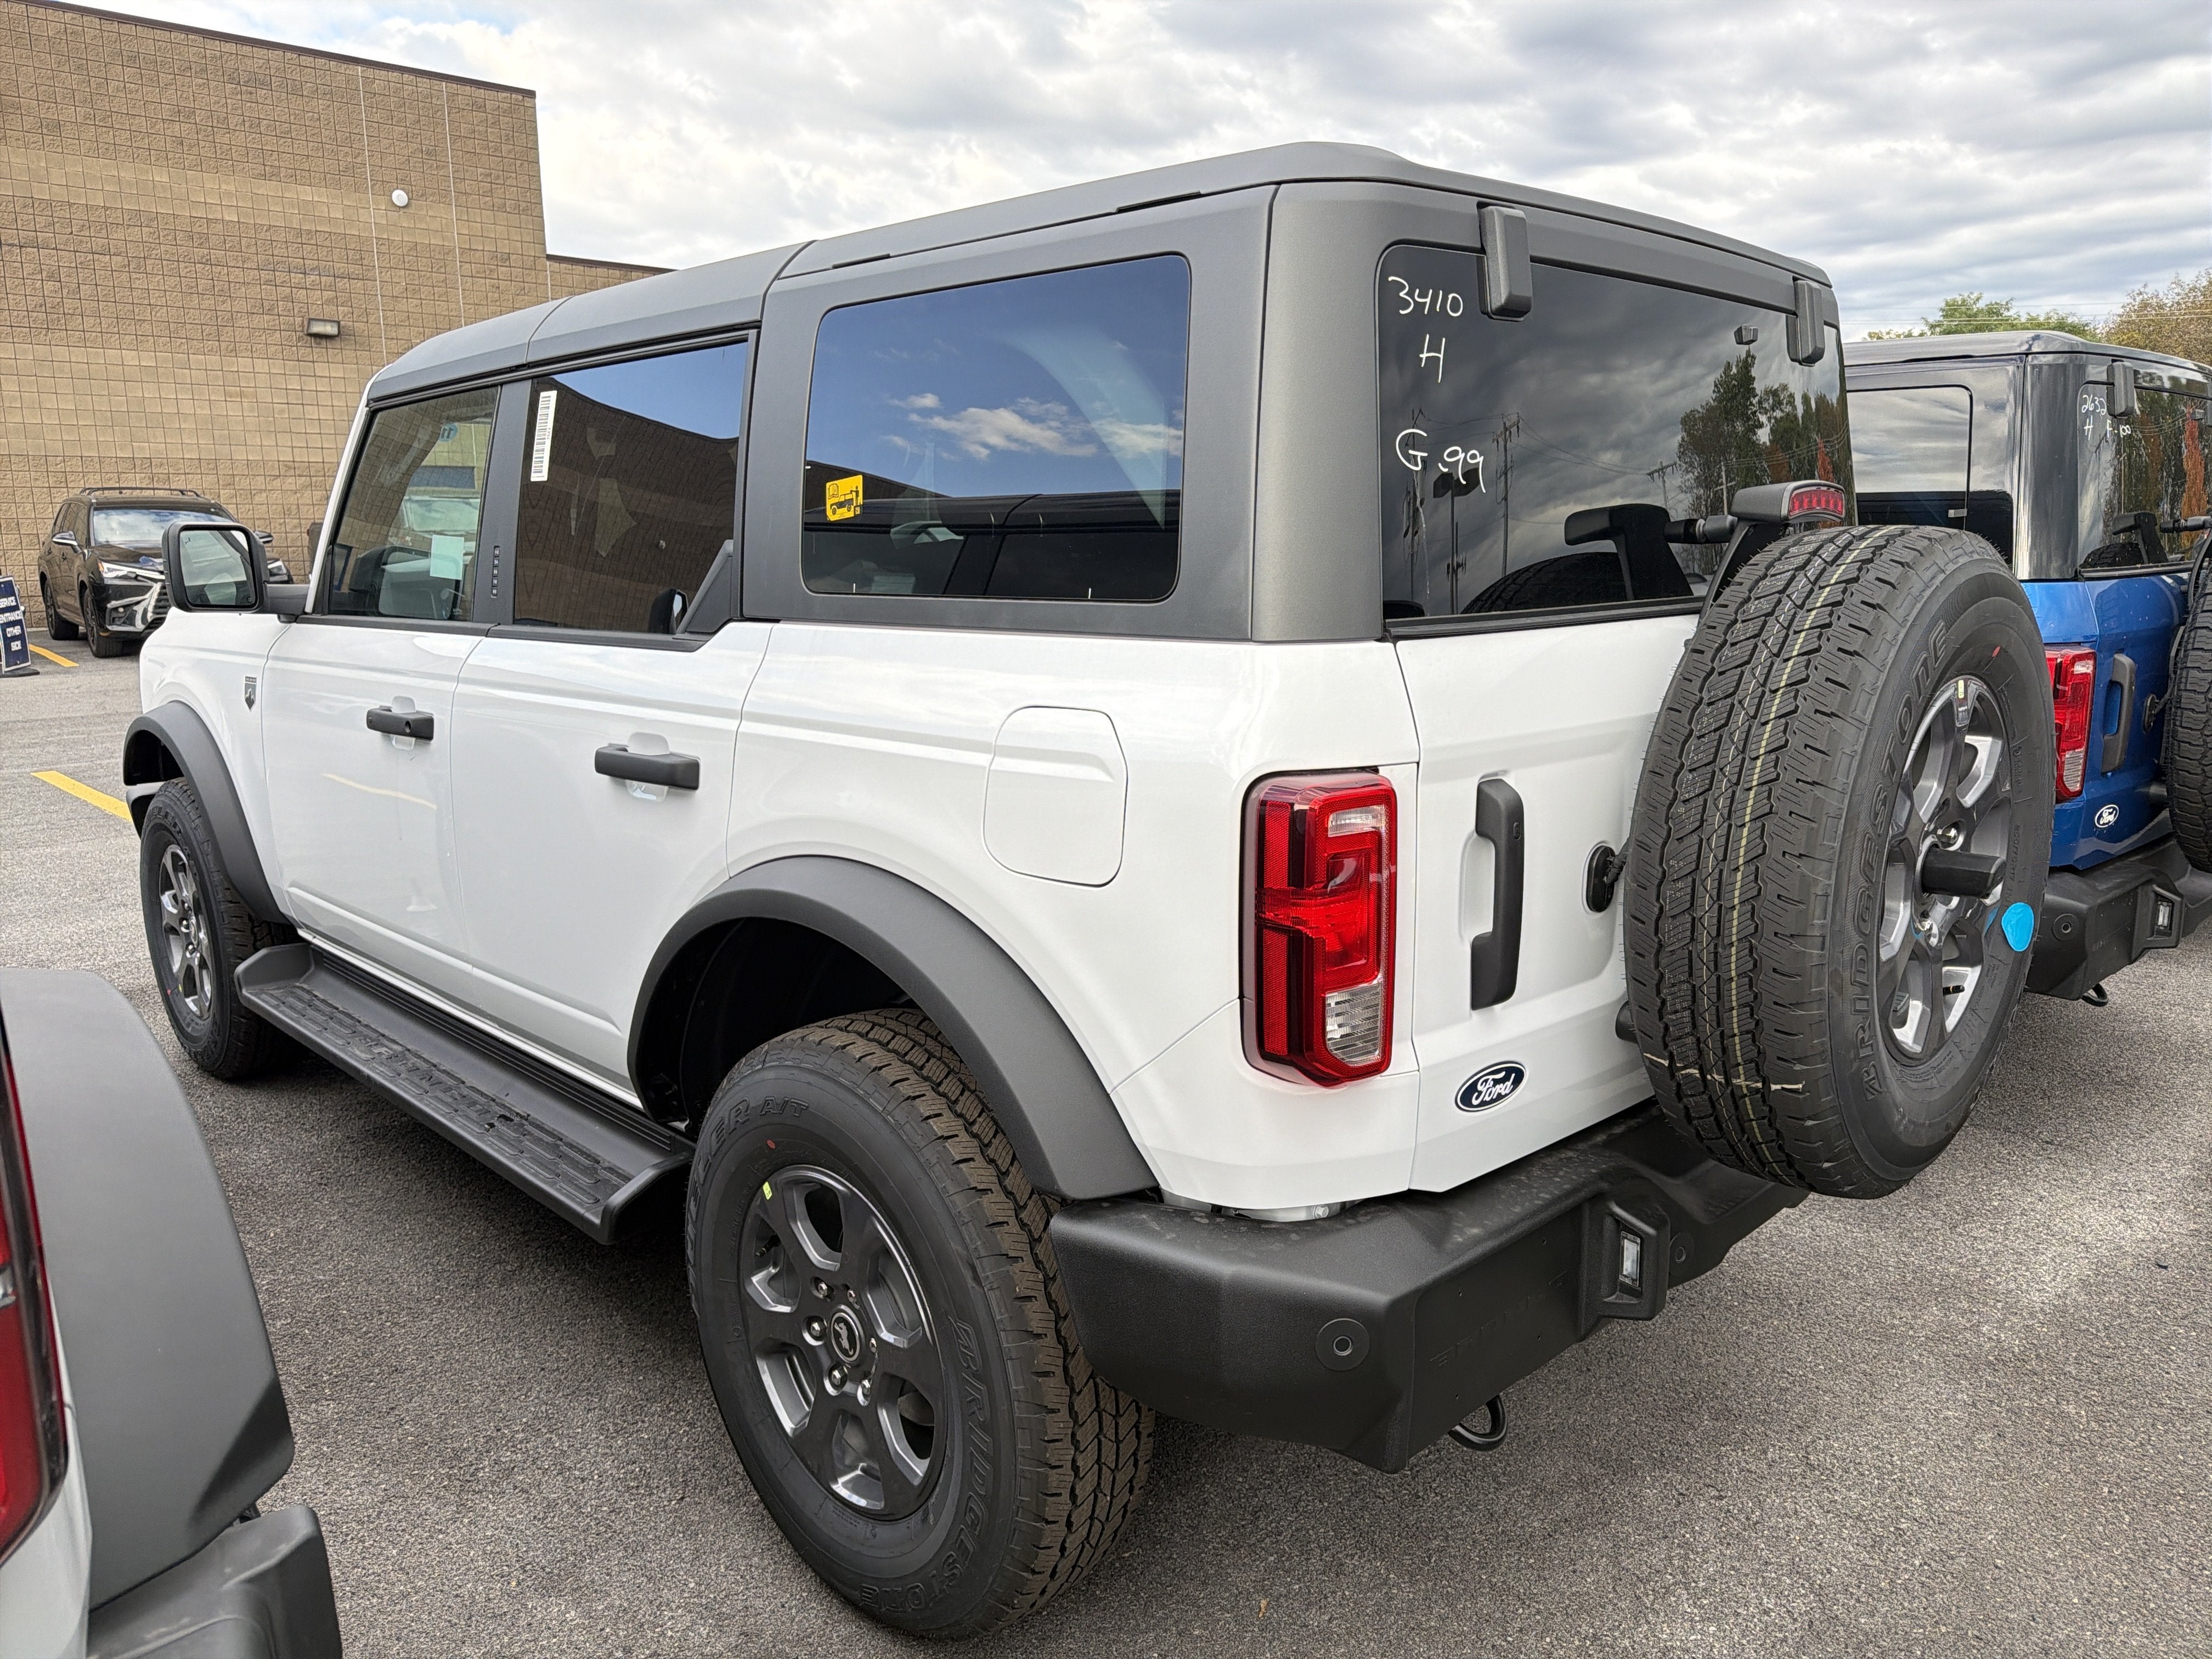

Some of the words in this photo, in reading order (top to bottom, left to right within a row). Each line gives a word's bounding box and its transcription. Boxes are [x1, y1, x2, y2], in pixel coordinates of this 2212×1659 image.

[1387, 276, 1464, 317] 3410
[1419, 333, 1446, 383] H
[2081, 393, 2107, 416] 2632
[2084, 415, 2094, 442] H
[6, 625, 22, 638] OTHER
[10, 640, 22, 652] SIDE
[2100, 808, 2116, 825] Ford
[1850, 619, 1948, 1102] BRIDGESTONE
[1471, 1070, 1516, 1105] Ford
[759, 1095, 810, 1117] A/T
[859, 1317, 994, 1613] BRIDGESTONE
